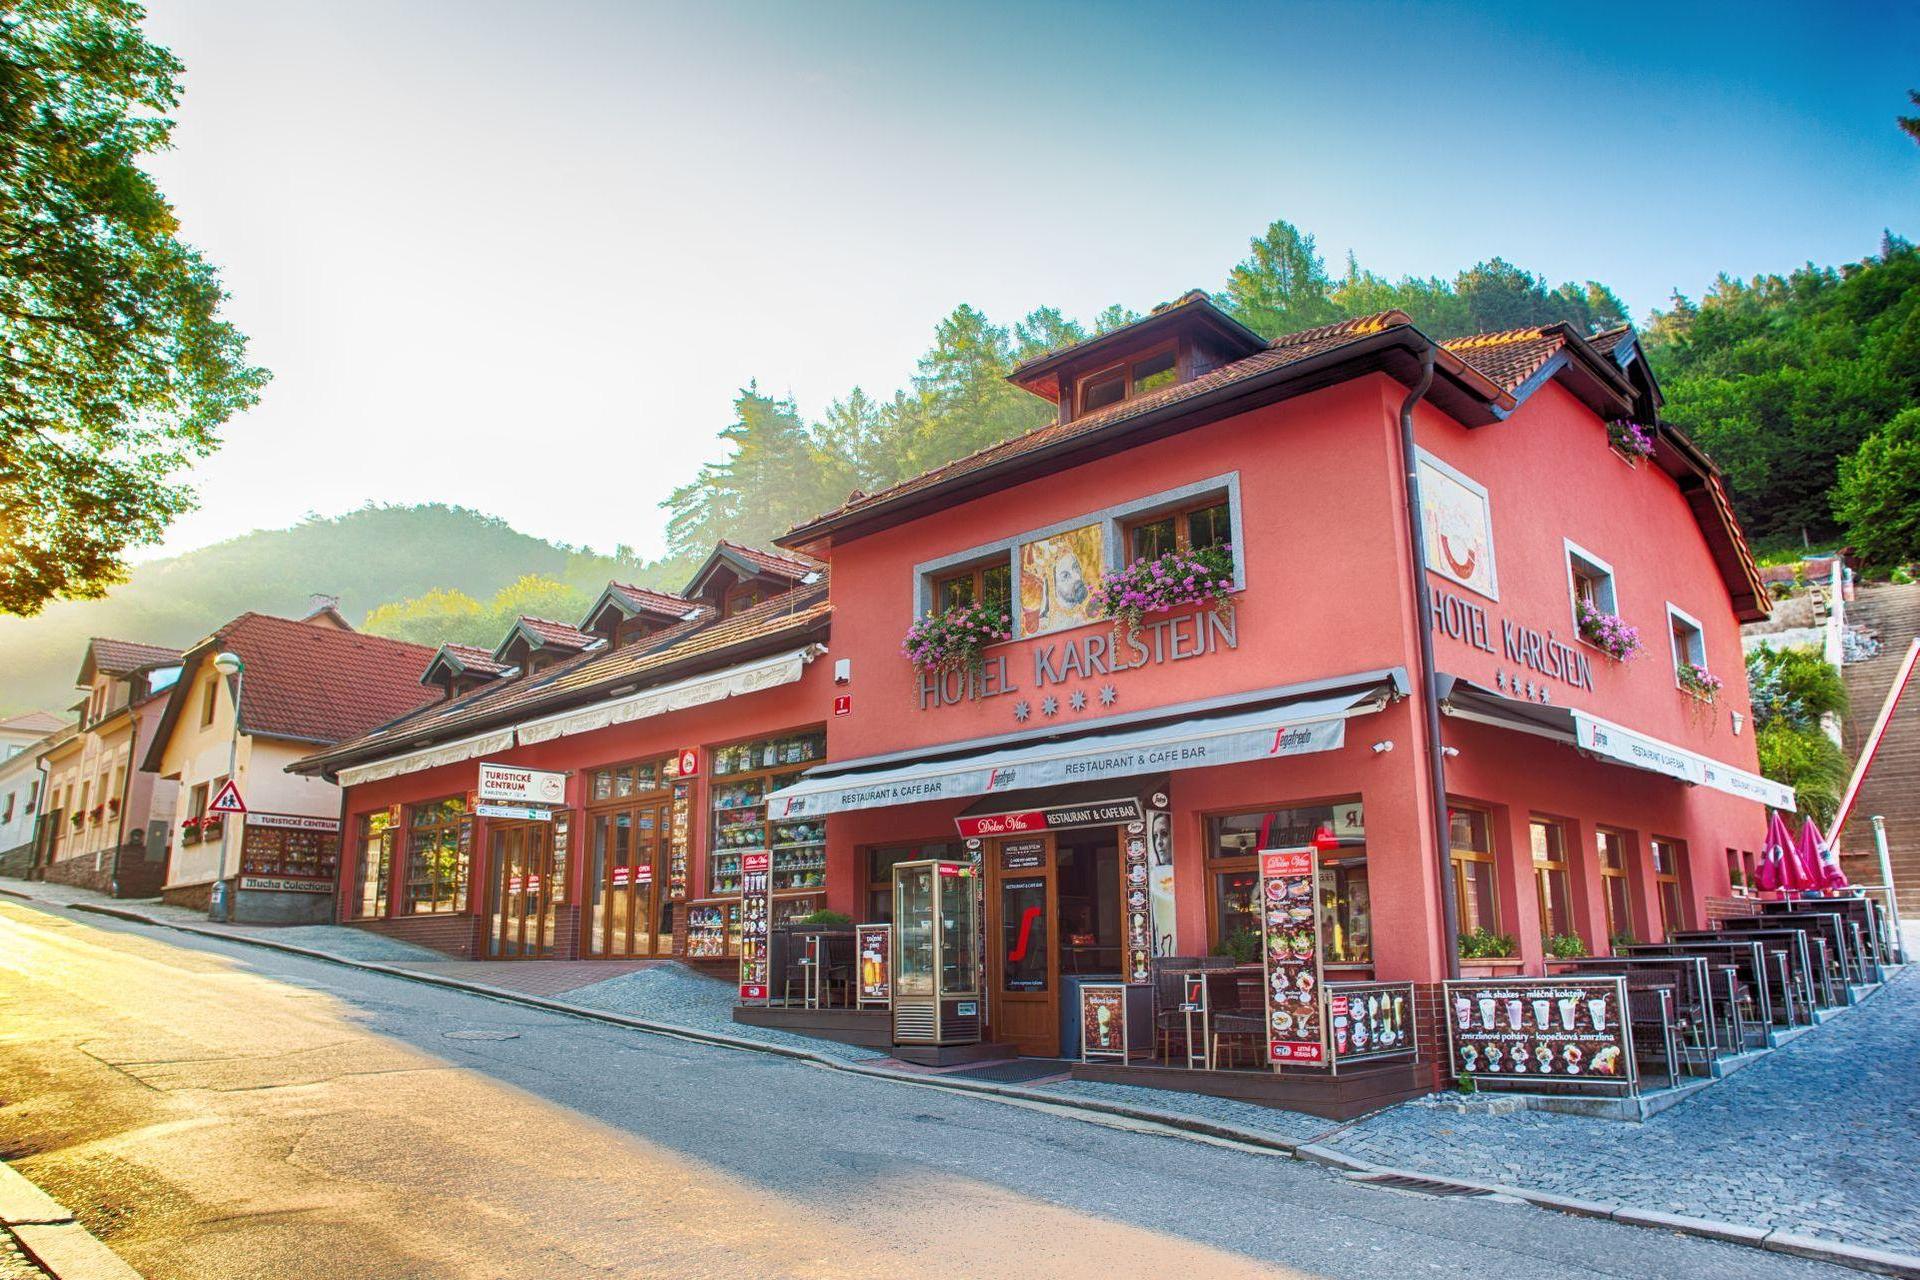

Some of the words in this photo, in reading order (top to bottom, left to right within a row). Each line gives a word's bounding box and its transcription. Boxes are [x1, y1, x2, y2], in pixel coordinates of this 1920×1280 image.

[1428, 584, 1496, 653] HOTEL
[1502, 618, 1594, 692] KARLŠTEJN
[919, 656, 1018, 710] HOTEL
[1270, 727, 1312, 754] Segafredo
[1065, 756, 1134, 775] RESTAURANT
[1138, 756, 1145, 764] &
[1149, 750, 1178, 764] CAFE
[1182, 746, 1206, 759] BAR
[485, 771, 532, 783] TURISTICKÉ
[485, 780, 526, 791] CENTRUM
[842, 789, 890, 805] RESTAURANT
[892, 788, 898, 797] &
[901, 785, 922, 796] CAFE
[924, 782, 942, 793] BAR
[261, 816, 301, 827] TURISTICKÉ
[303, 820, 337, 829] CENTRUM
[977, 818, 1004, 834] Dolce
[1004, 813, 1028, 830] Vita
[1048, 811, 1092, 825] RESTAURANT
[1093, 810, 1100, 819] &
[1100, 808, 1120, 819] CAFE
[1119, 806, 1136, 818] BAR
[246, 879, 280, 889] Mucha
[1476, 989, 1492, 999] milk
[1493, 989, 1519, 999] shakes
[1526, 989, 1553, 999] mléčné
[1555, 989, 1587, 1000] koktejly
[1461, 1031, 1500, 1041] zmrzlinové
[1502, 1032, 1529, 1042] poháry
[1536, 1032, 1578, 1042] kopečková
[1579, 1032, 1614, 1041] zmrzlina
